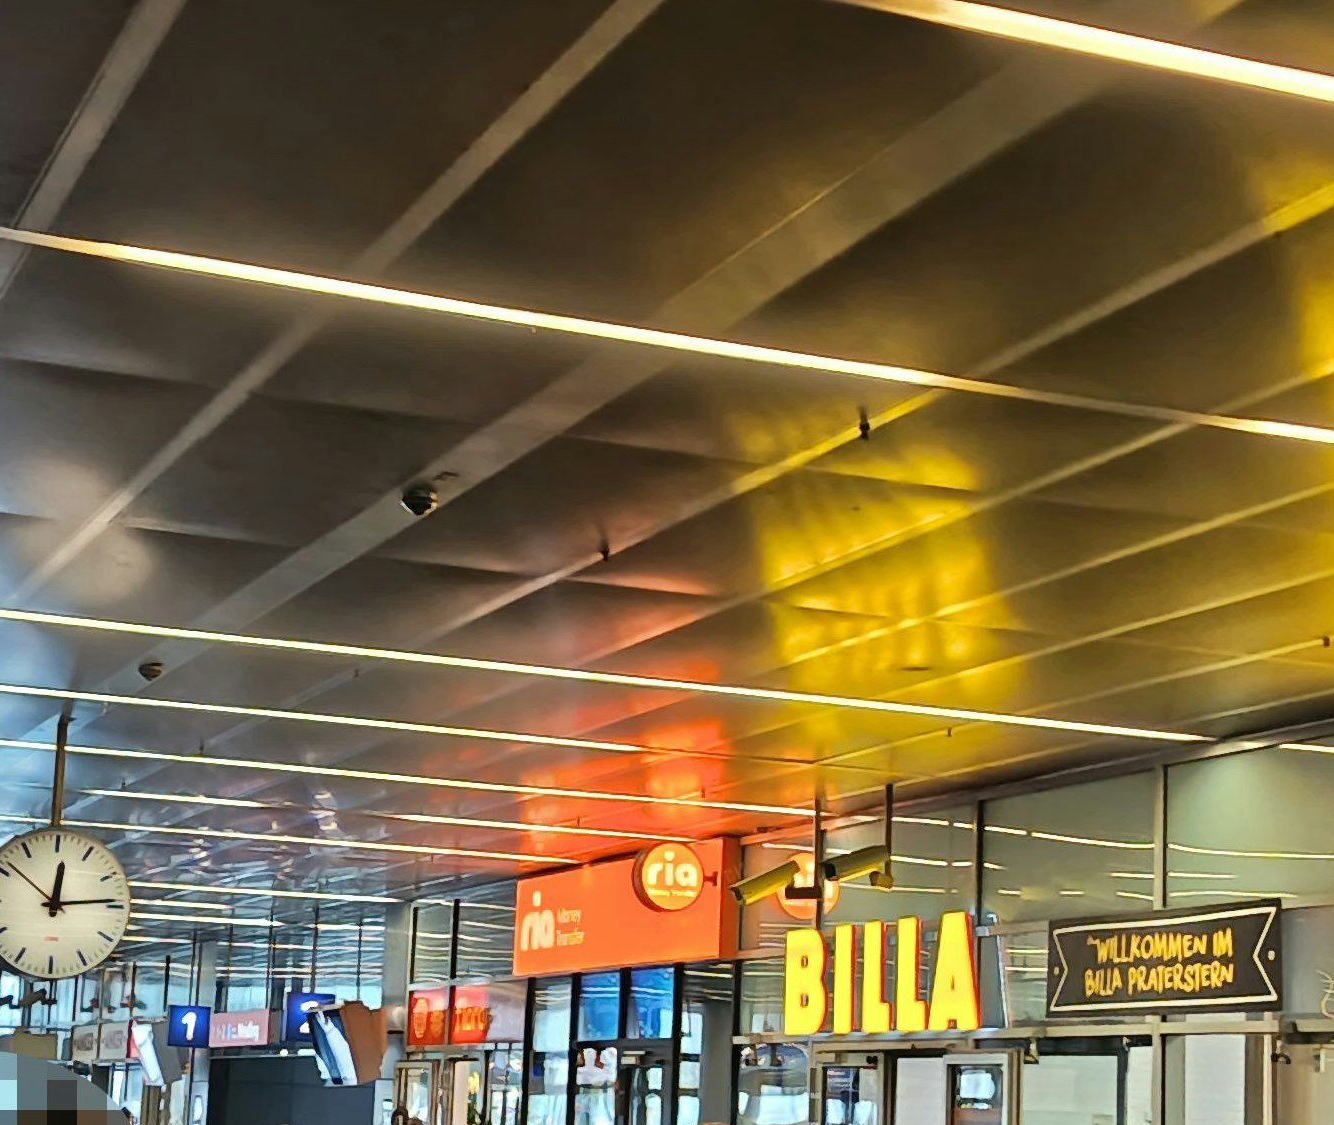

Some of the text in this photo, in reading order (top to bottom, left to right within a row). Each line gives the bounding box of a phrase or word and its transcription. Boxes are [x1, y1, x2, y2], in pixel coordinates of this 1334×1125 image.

[647, 850, 698, 887] ria
[520, 890, 555, 951] ria
[1088, 927, 1234, 963] WILLKOMMEN IM
[784, 910, 982, 1036] BILLA
[1084, 960, 1235, 998] BILLA PRATERSTERN
[181, 1011, 197, 1041] 1
